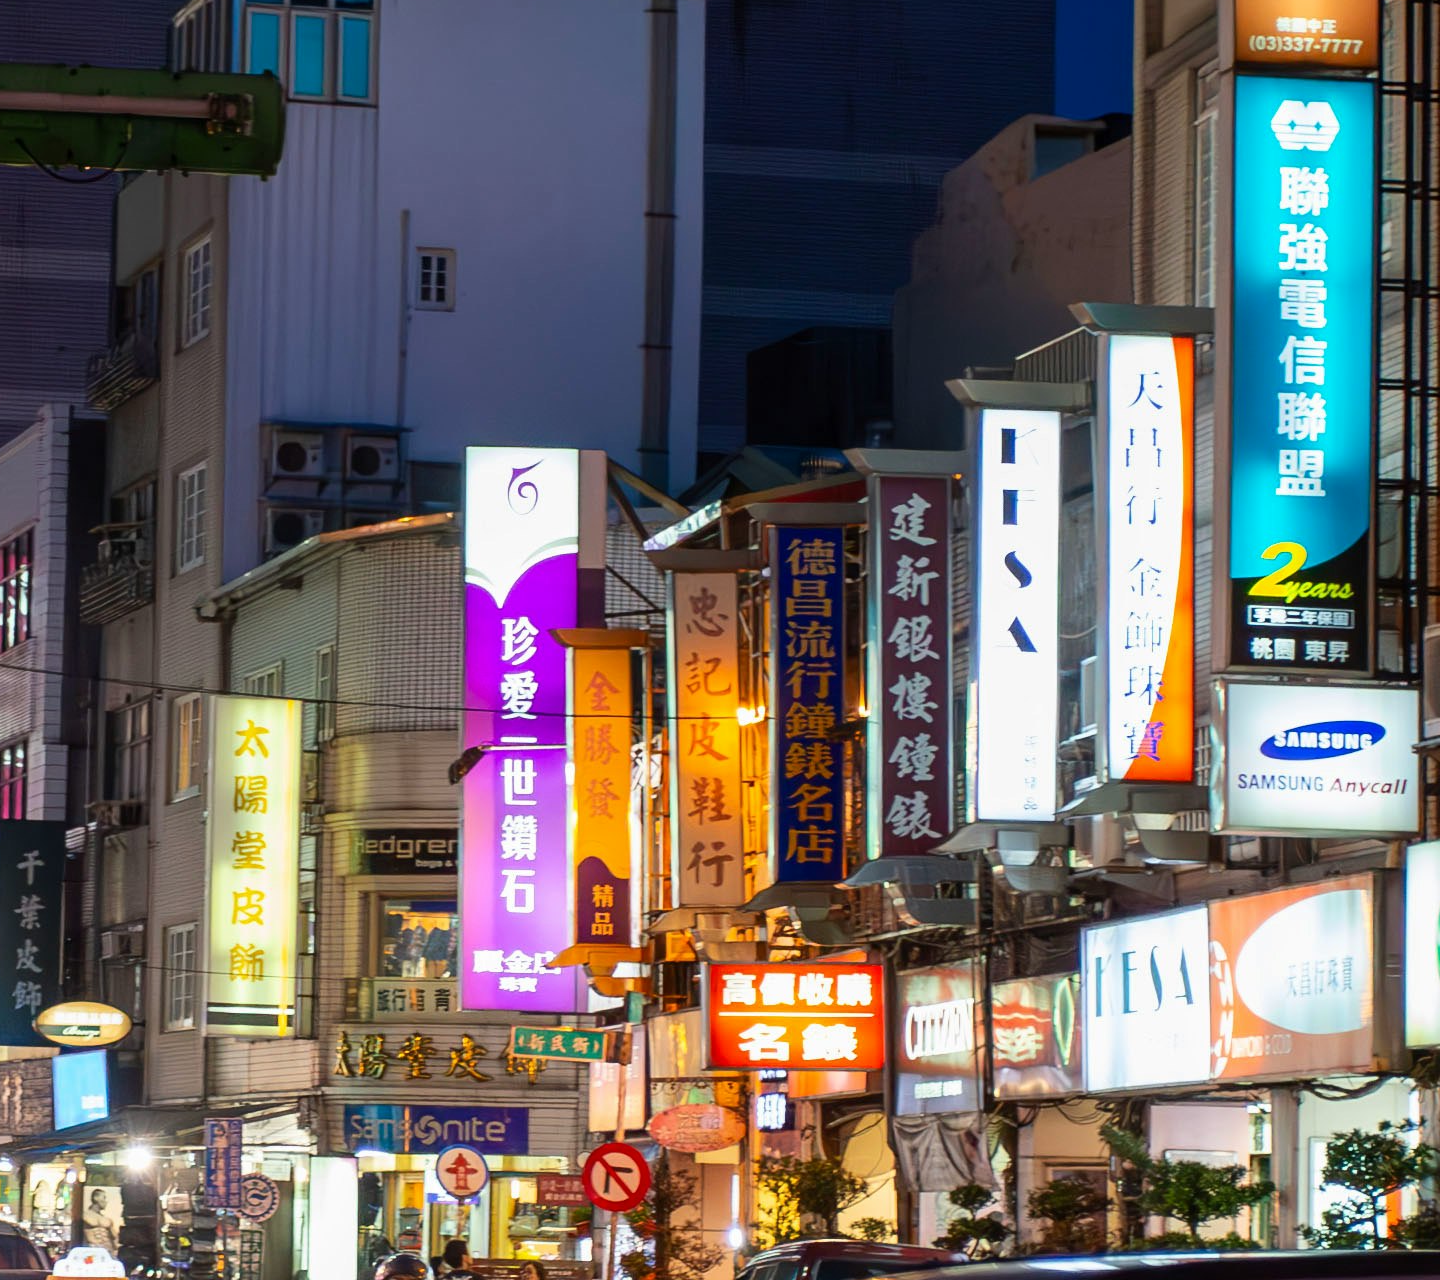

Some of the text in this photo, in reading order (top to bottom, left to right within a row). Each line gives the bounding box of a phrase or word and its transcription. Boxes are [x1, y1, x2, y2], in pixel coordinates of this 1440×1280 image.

[1248, 35, 1364, 55] (03)337-7777
[1275, 166, 1331, 498] 聯強電信聯盟
[1284, 581, 1355, 604] years
[886, 493, 943, 841] 建新銀樓鐘錶
[1251, 637, 1350, 662] 桃園 東昇
[784, 538, 837, 865] 德昌流行鐘錶名店
[500, 616, 539, 914] 珍愛一世鑽石
[1273, 730, 1374, 751] SAMSUNG
[1237, 774, 1408, 797] SAMSUNG Anycall
[229, 719, 269, 983] 太陽堂皮飾
[591, 884, 614, 937] 精品
[722, 972, 873, 1007] 高價收購
[1093, 945, 1194, 1018] KESA
[738, 1022, 859, 1062] 名錶
[905, 997, 975, 1061] CITIZEN
